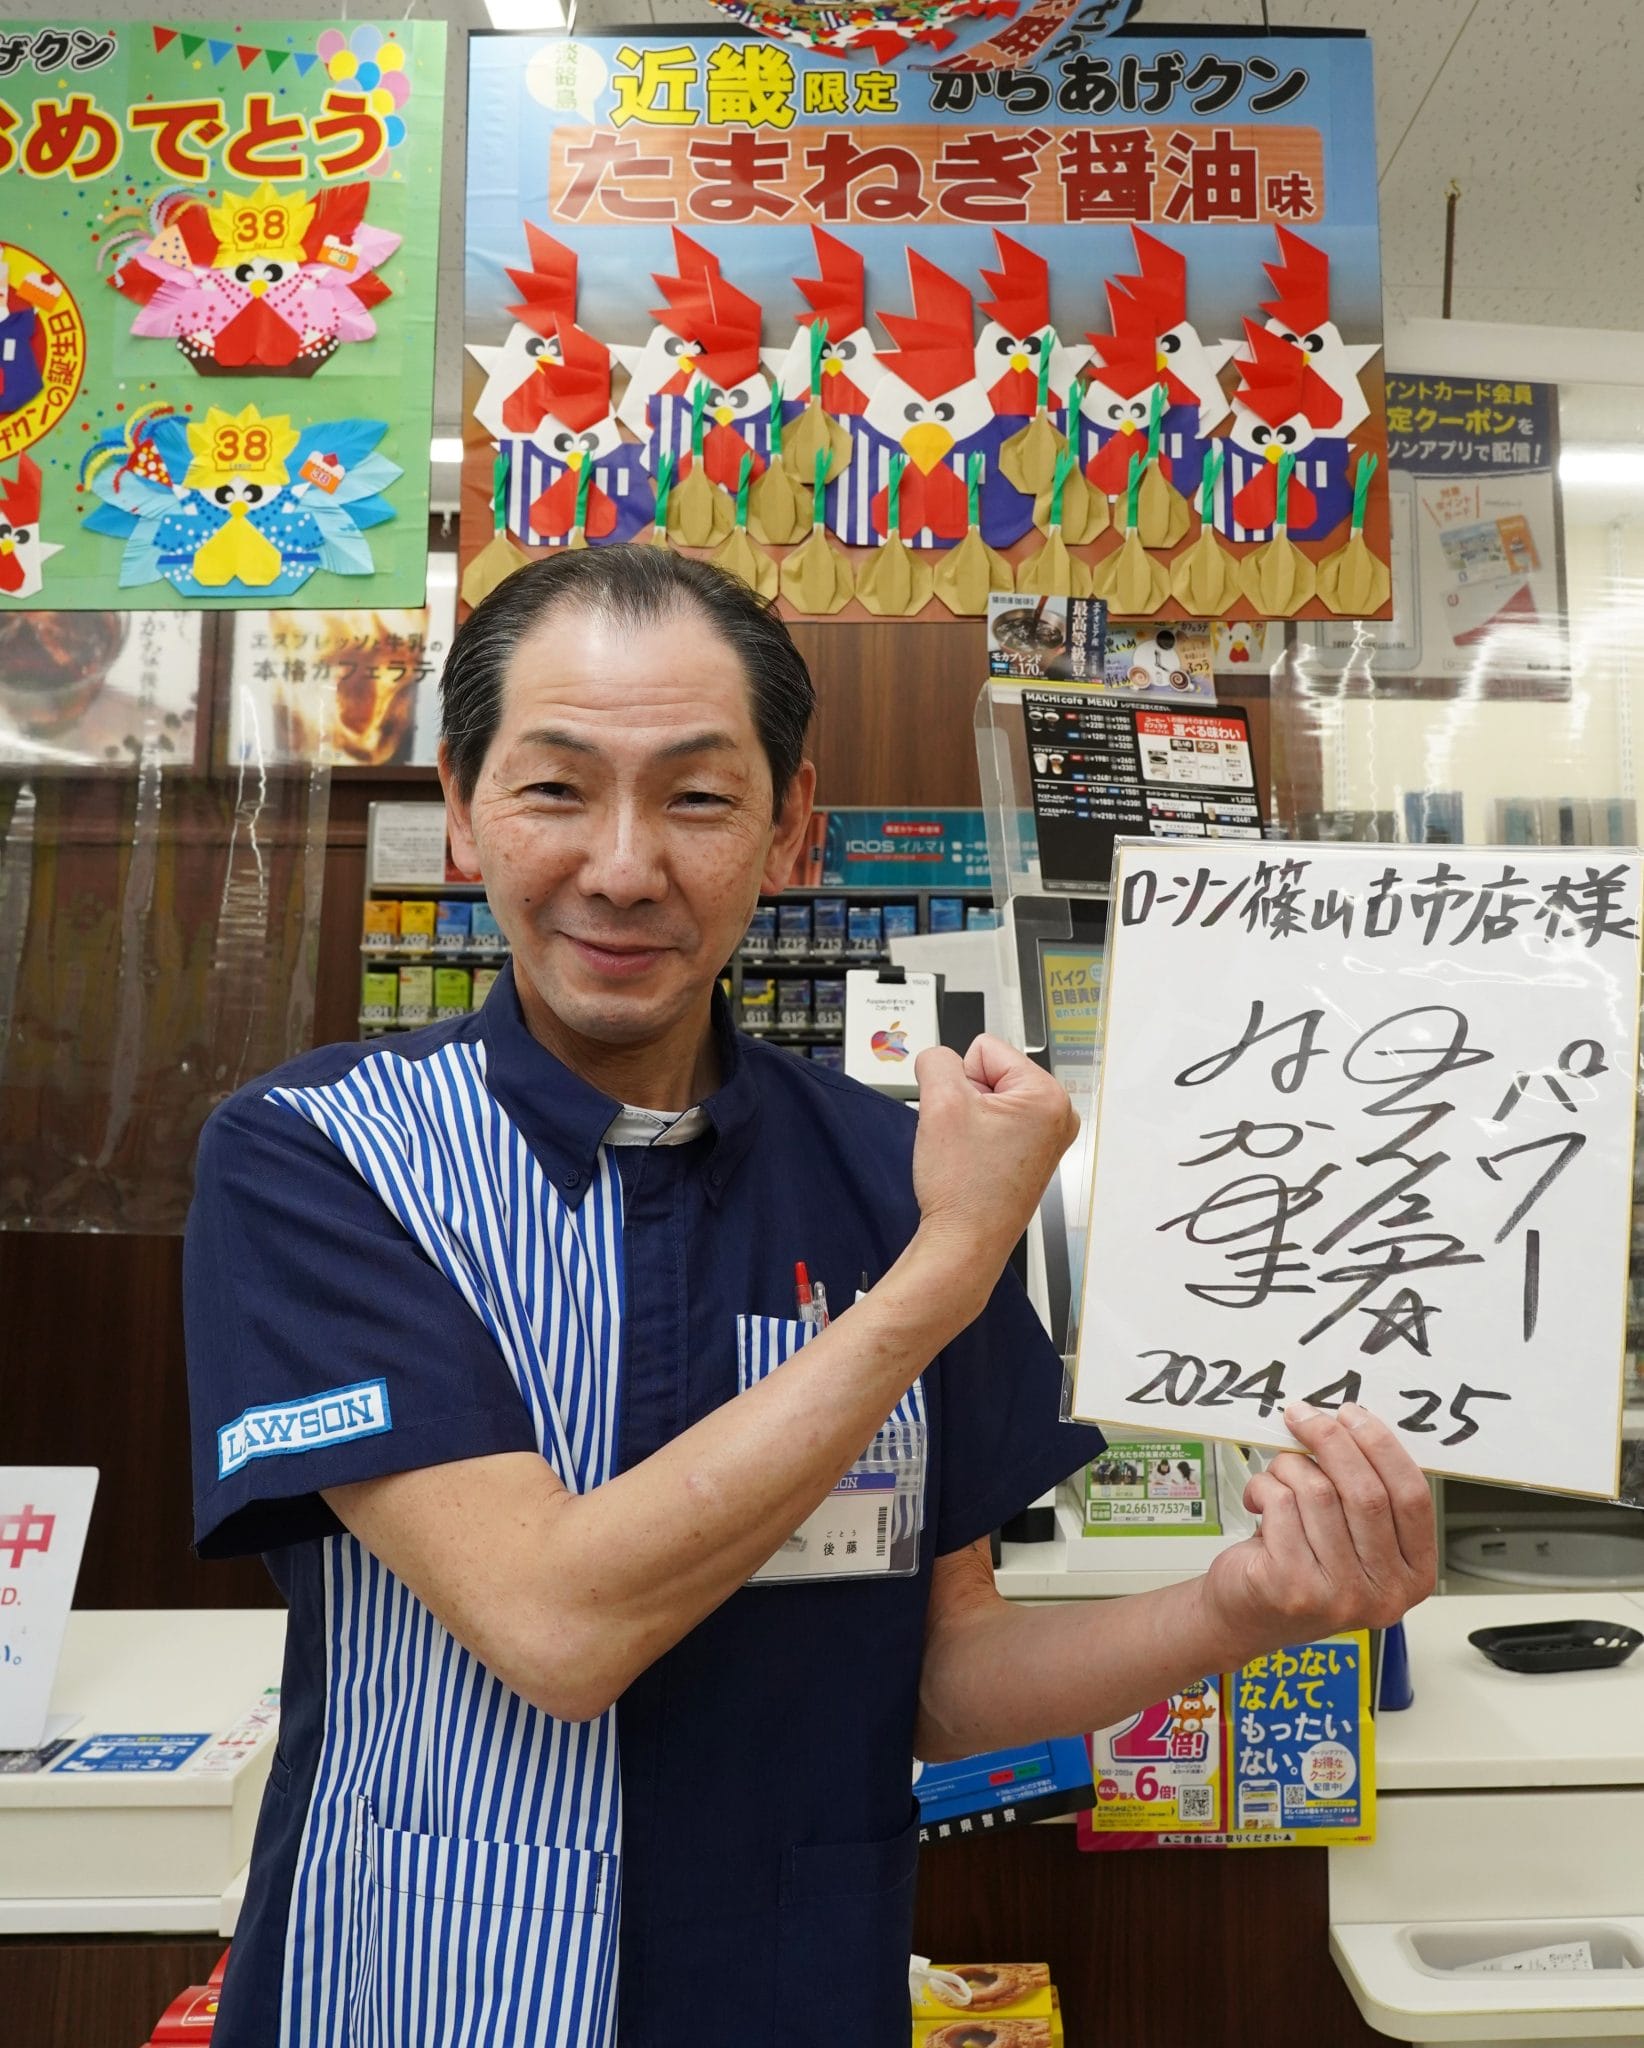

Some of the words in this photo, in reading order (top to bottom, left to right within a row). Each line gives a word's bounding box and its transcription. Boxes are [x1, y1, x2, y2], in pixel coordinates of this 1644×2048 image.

[237, 209, 285, 242] 38
[217, 430, 267, 462] 38
[253, 657, 436, 683] 本格カフェラテ
[1087, 697, 1118, 708] MENU
[846, 840, 895, 854] IQOS
[367, 934, 392, 946] 701
[403, 934, 428, 946] 702
[438, 935, 464, 947] 703
[474, 936, 500, 948] 704
[748, 938, 768, 948] 711
[783, 938, 805, 948] 712
[818, 938, 842, 948] 713
[854, 939, 877, 949] 714
[1050, 970, 1087, 986] バイク
[747, 1011, 769, 1022] 611
[781, 1011, 806, 1022] 612
[817, 1011, 842, 1022] 613
[227, 1394, 374, 1463] LAWSON
[824, 1541, 857, 1556] 後藤
[1241, 1712, 1352, 1743] もったい
[1312, 1757, 1344, 1769] お得な
[1310, 1769, 1346, 1781] クーポン
